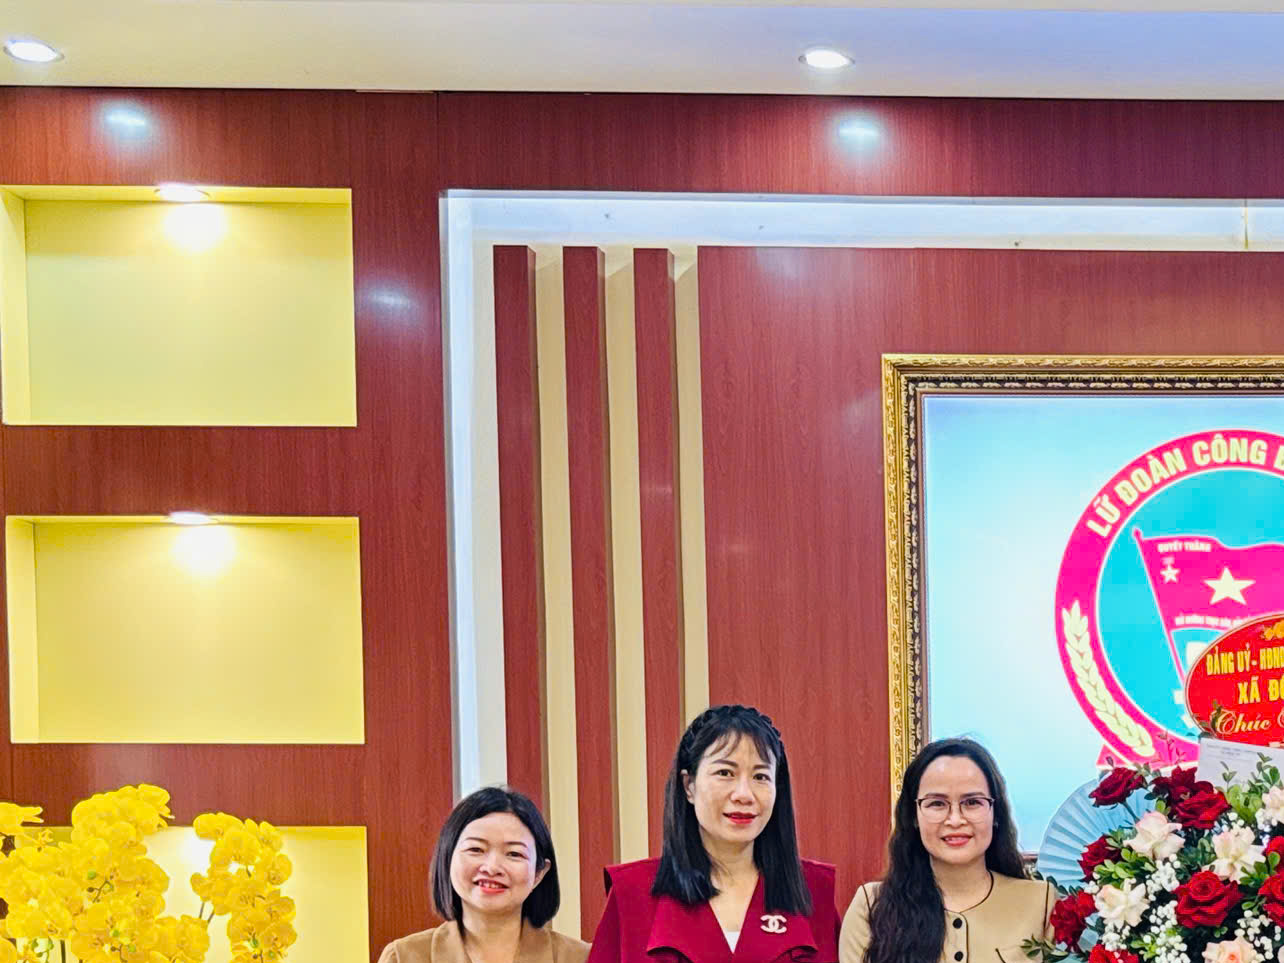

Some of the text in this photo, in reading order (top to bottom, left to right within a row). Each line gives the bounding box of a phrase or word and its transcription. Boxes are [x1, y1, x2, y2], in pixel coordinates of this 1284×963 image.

[1086, 494, 1121, 537] LỮ
[1113, 447, 1187, 506] ĐOÀN
[1192, 433, 1268, 466] CÔNG
[1206, 645, 1235, 676] ĐẢNG
[1237, 675, 1261, 705] XÃ
[1210, 708, 1271, 735] Chúc
